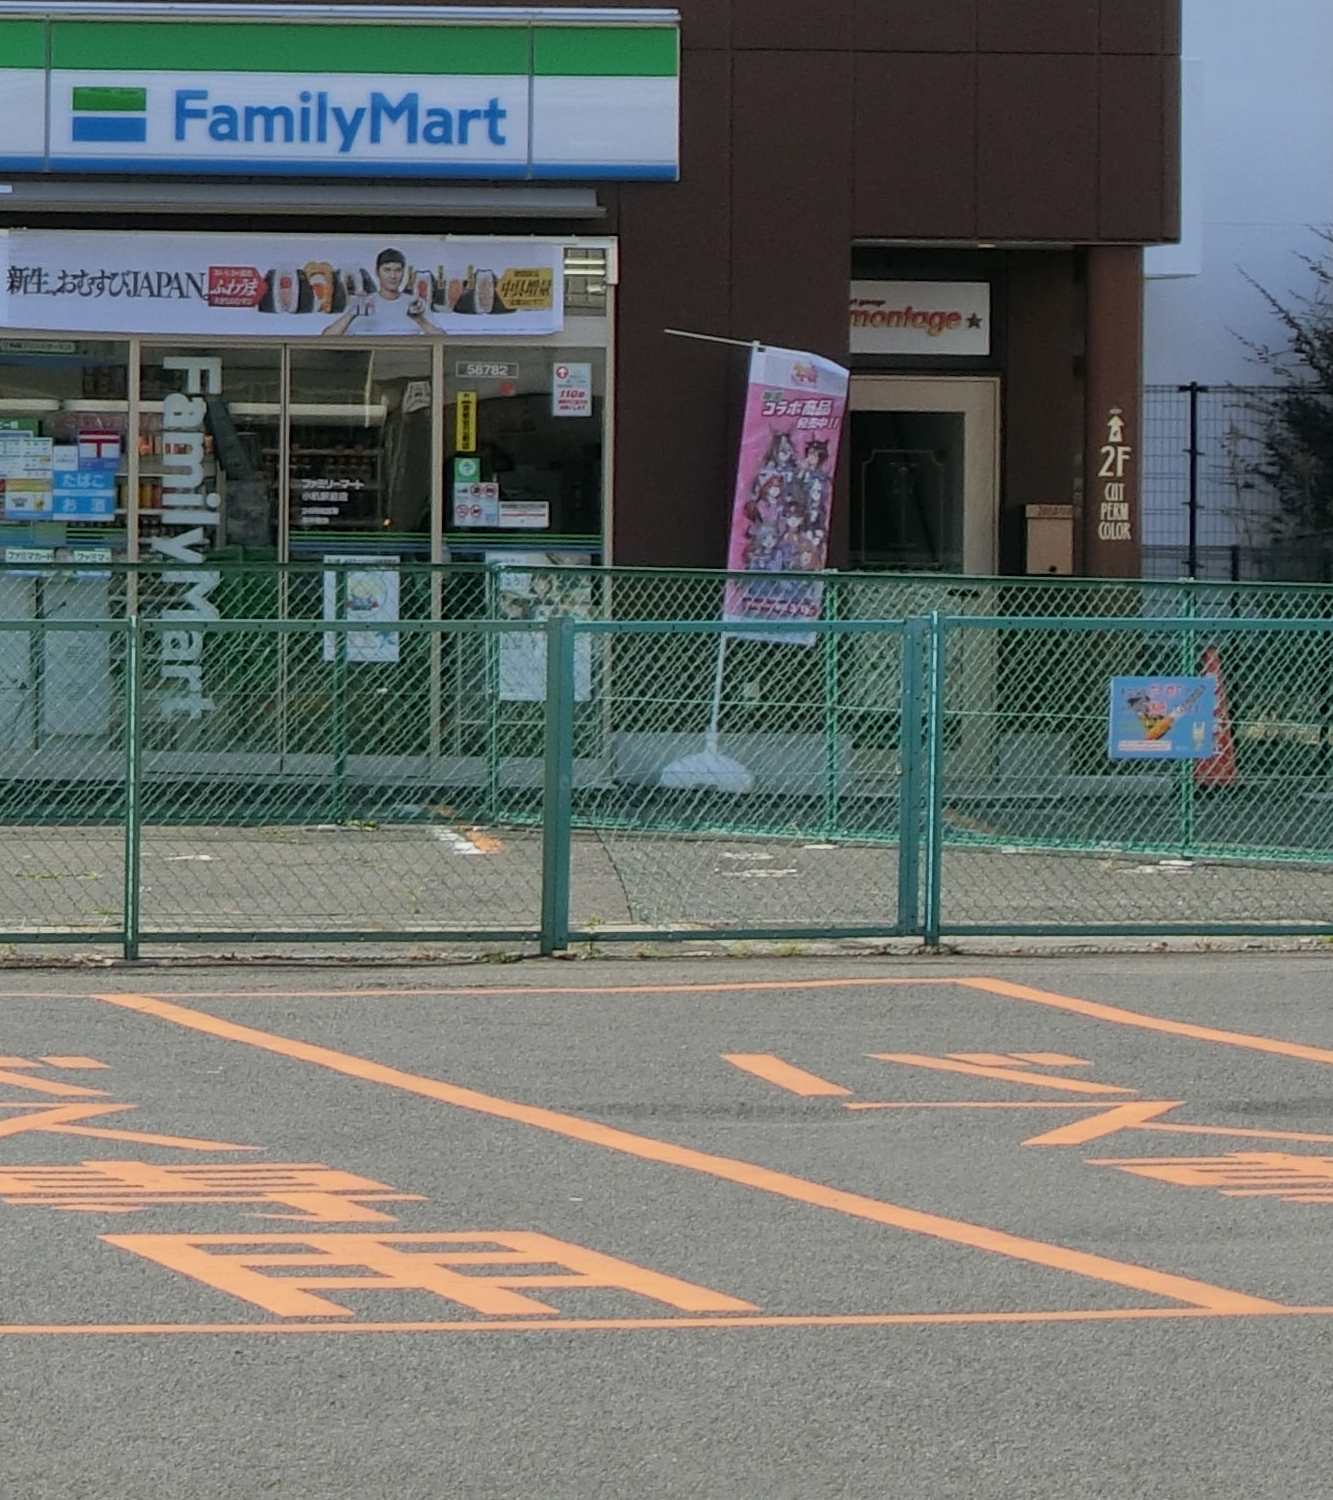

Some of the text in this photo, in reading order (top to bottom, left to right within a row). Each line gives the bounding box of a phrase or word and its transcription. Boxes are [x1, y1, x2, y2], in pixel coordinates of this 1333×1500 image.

[174, 88, 508, 153] FamilyMart
[1097, 445, 1132, 477] 2F
[62, 471, 106, 488] たばこ
[1104, 482, 1125, 501] CUT
[1099, 502, 1129, 521] PERM
[1097, 521, 1132, 541] COLOR
